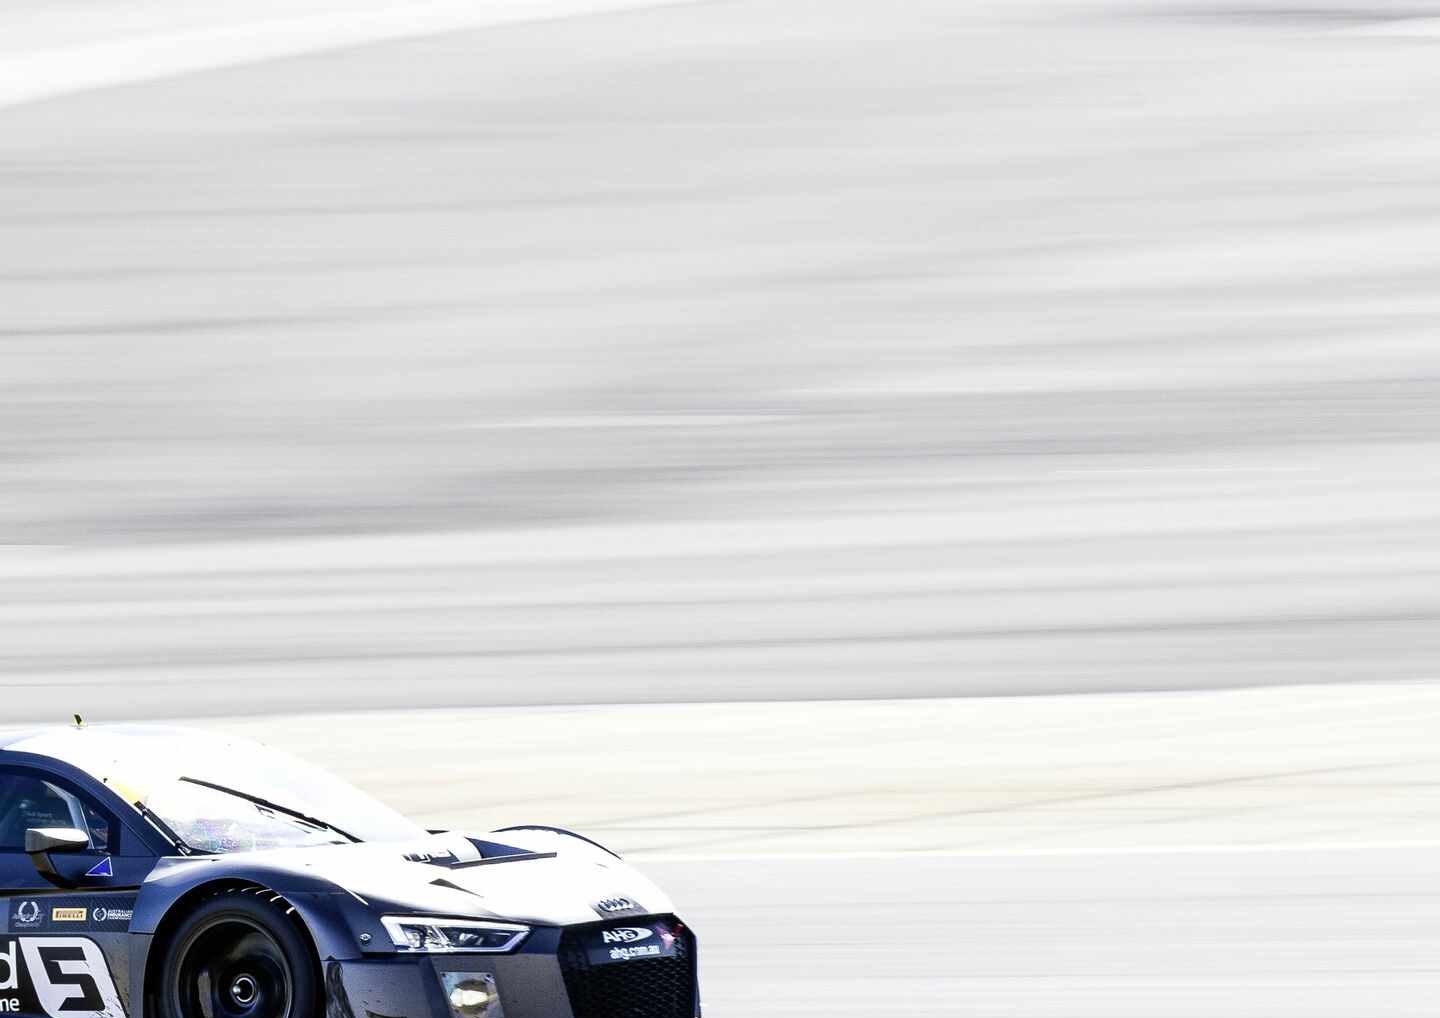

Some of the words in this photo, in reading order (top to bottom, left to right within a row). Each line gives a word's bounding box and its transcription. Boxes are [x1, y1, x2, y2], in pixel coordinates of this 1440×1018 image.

[55, 910, 84, 919] PIRELLI
[602, 930, 637, 943] AHG
[609, 945, 661, 960] ahg.com.au
[37, 946, 106, 1011] 5
